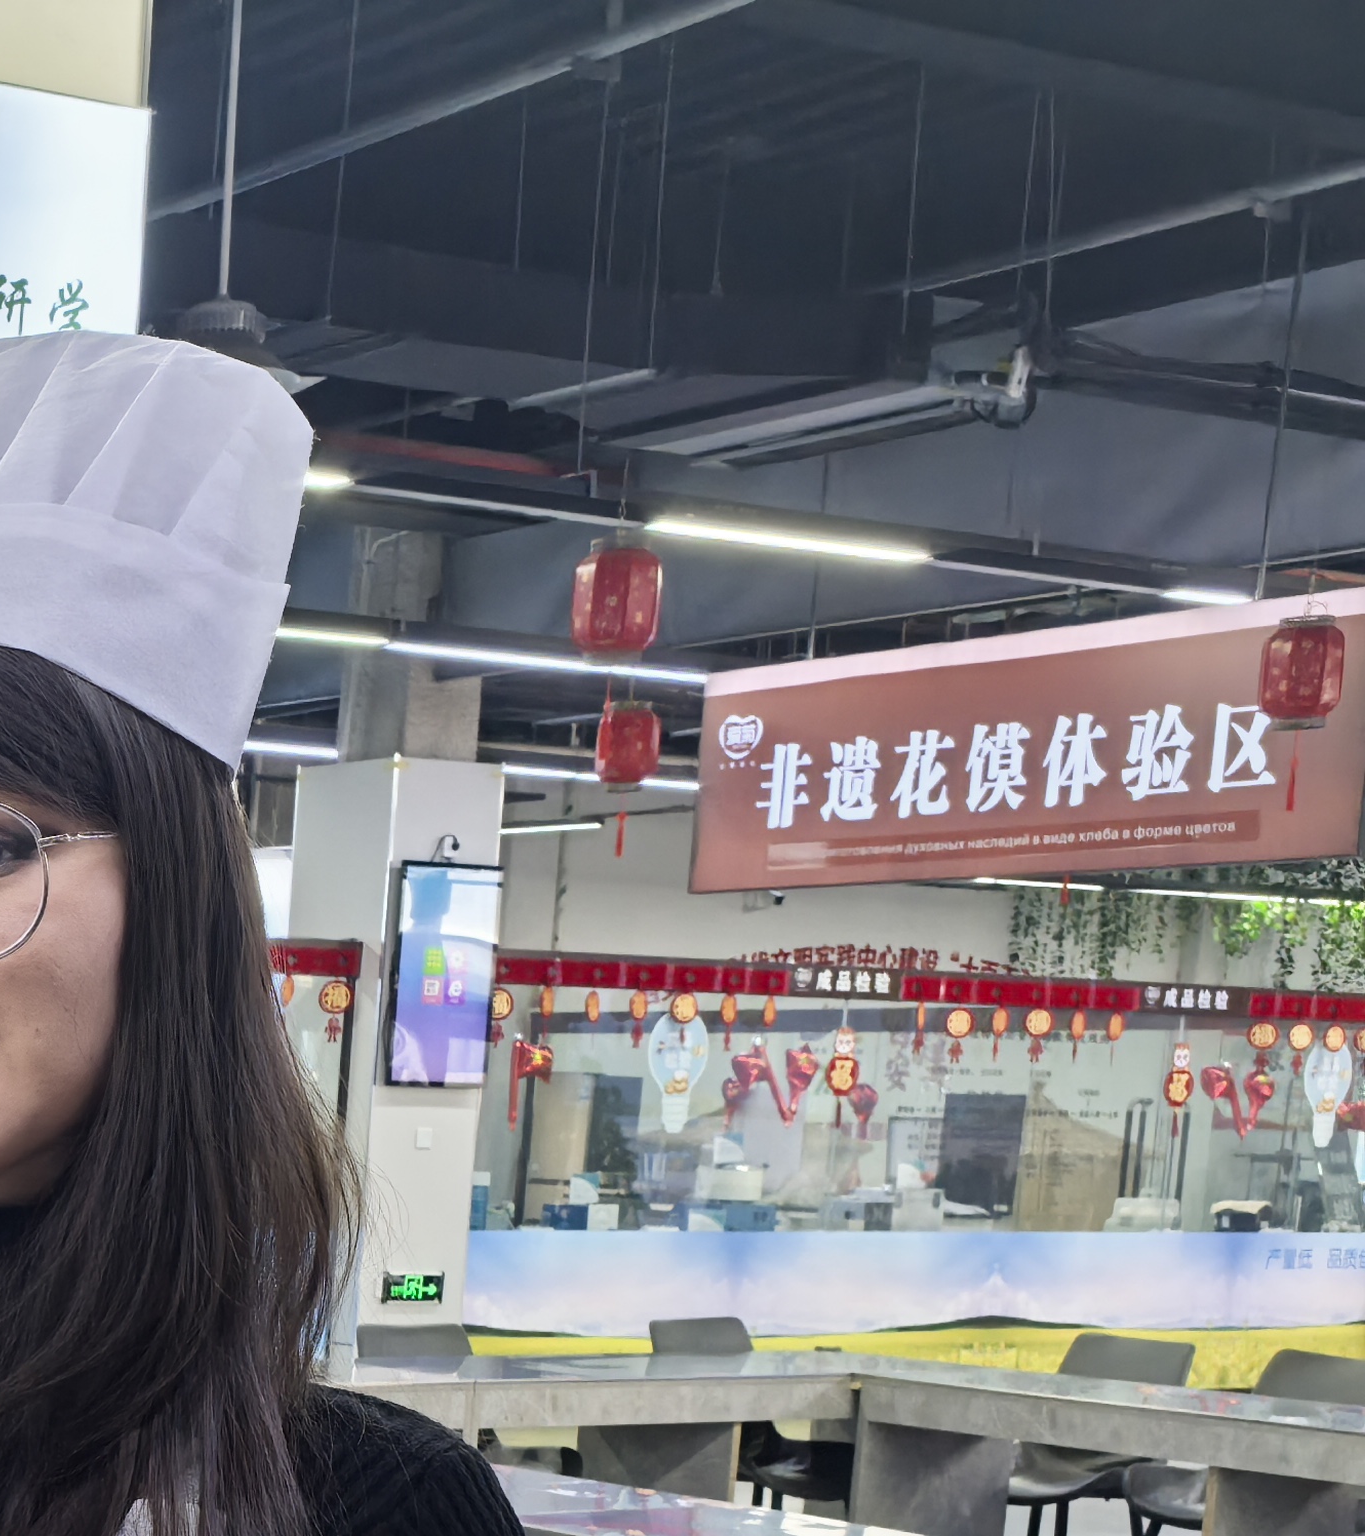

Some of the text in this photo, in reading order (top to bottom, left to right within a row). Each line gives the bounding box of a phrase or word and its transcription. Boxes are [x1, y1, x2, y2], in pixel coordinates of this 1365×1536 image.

[755, 703, 1276, 829] 非遗花馍体验区
[1043, 831, 1075, 845] виде
[1079, 827, 1119, 843] хлеба
[1133, 825, 1182, 843] форме
[1185, 820, 1236, 838] цветов
